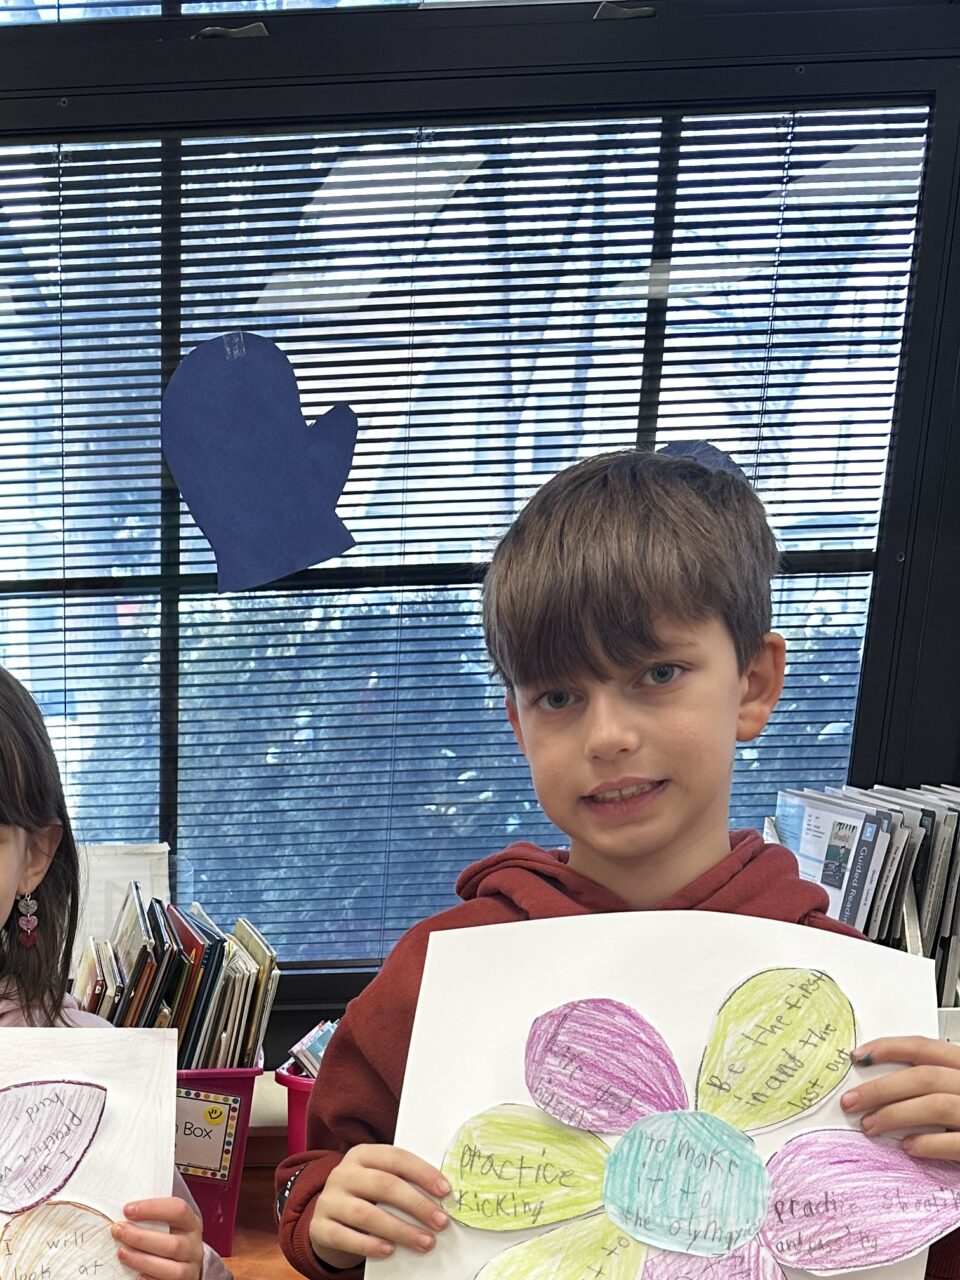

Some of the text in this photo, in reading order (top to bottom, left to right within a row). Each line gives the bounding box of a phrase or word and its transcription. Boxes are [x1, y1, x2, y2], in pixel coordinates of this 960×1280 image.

[850, 847, 867, 890] Guided
[839, 891, 858, 923] Readin
[707, 1063, 746, 1093] Be
[741, 1015, 792, 1046] the
[765, 1048, 804, 1090] and
[799, 1023, 837, 1048] the
[17, 1108, 82, 1162] practice
[183, 1121, 213, 1140] Box
[23, 1150, 73, 1194] I will
[678, 1136, 739, 1176] make
[3, 1231, 84, 1256] I will
[79, 1260, 104, 1275] at
